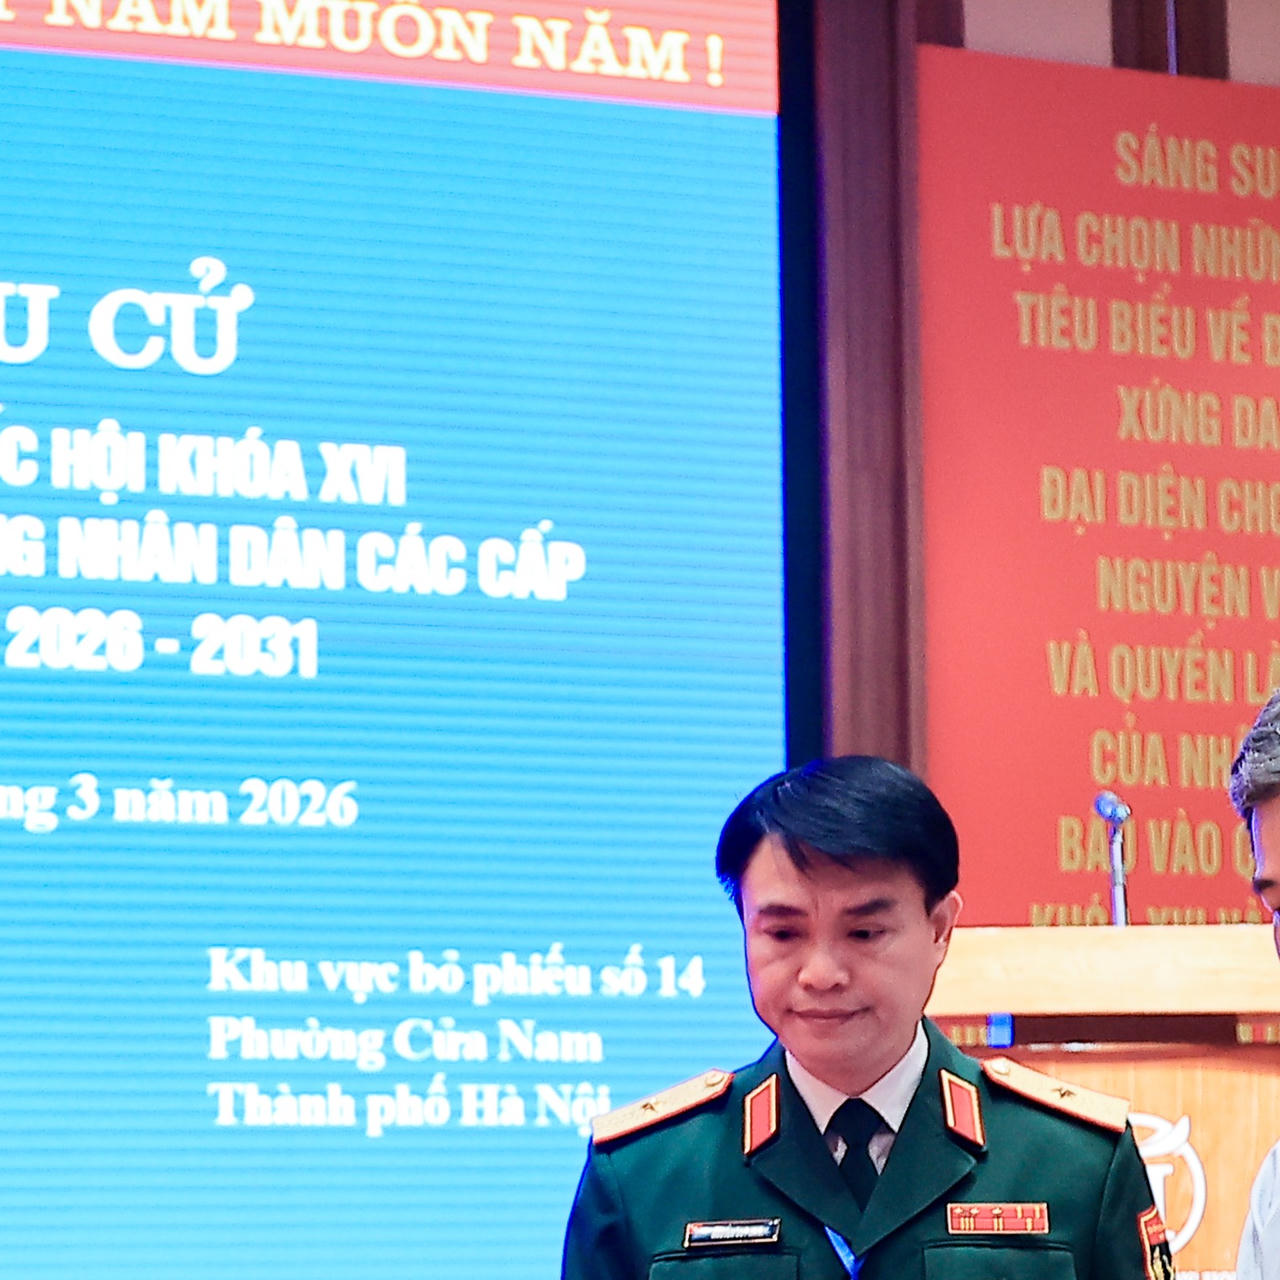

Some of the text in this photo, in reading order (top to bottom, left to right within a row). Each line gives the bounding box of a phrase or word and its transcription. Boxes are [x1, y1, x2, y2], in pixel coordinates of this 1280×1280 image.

[512, 9, 691, 83] NĂM
[1116, 123, 1218, 192] SÁNG
[992, 202, 1065, 272] LỰA
[1077, 212, 1180, 283] CHỌN
[88, 256, 255, 375] CỬ
[1014, 283, 1097, 351] TIÊU
[1110, 282, 1196, 359] BIỂU
[1117, 377, 1220, 446] XỨNG
[51, 418, 145, 504] HỘI
[158, 426, 308, 501] KHÓA
[319, 442, 406, 506] XVI
[1040, 465, 1106, 536] ĐẠI
[1118, 462, 1207, 541] DIỆN
[58, 509, 216, 584] NHÂN
[230, 515, 345, 590] DÂN
[357, 522, 467, 595] CÁC
[478, 519, 586, 600] CẤP
[1097, 550, 1249, 629] NGUYỆN
[4, 606, 144, 671] 2026
[190, 613, 318, 678] 2031
[1046, 628, 1099, 697] VÀ
[1091, 712, 1168, 786] CỦA
[67, 773, 100, 821] 3
[113, 778, 229, 824] năm
[238, 778, 359, 828] 2026
[1147, 808, 1222, 876] VÀO
[207, 943, 706, 1006] Khu vực bỏ phiếu số 14
[207, 1016, 604, 1072] Phường Cửa Nam
[207, 1073, 611, 1138] Thành phố Hà Nội
